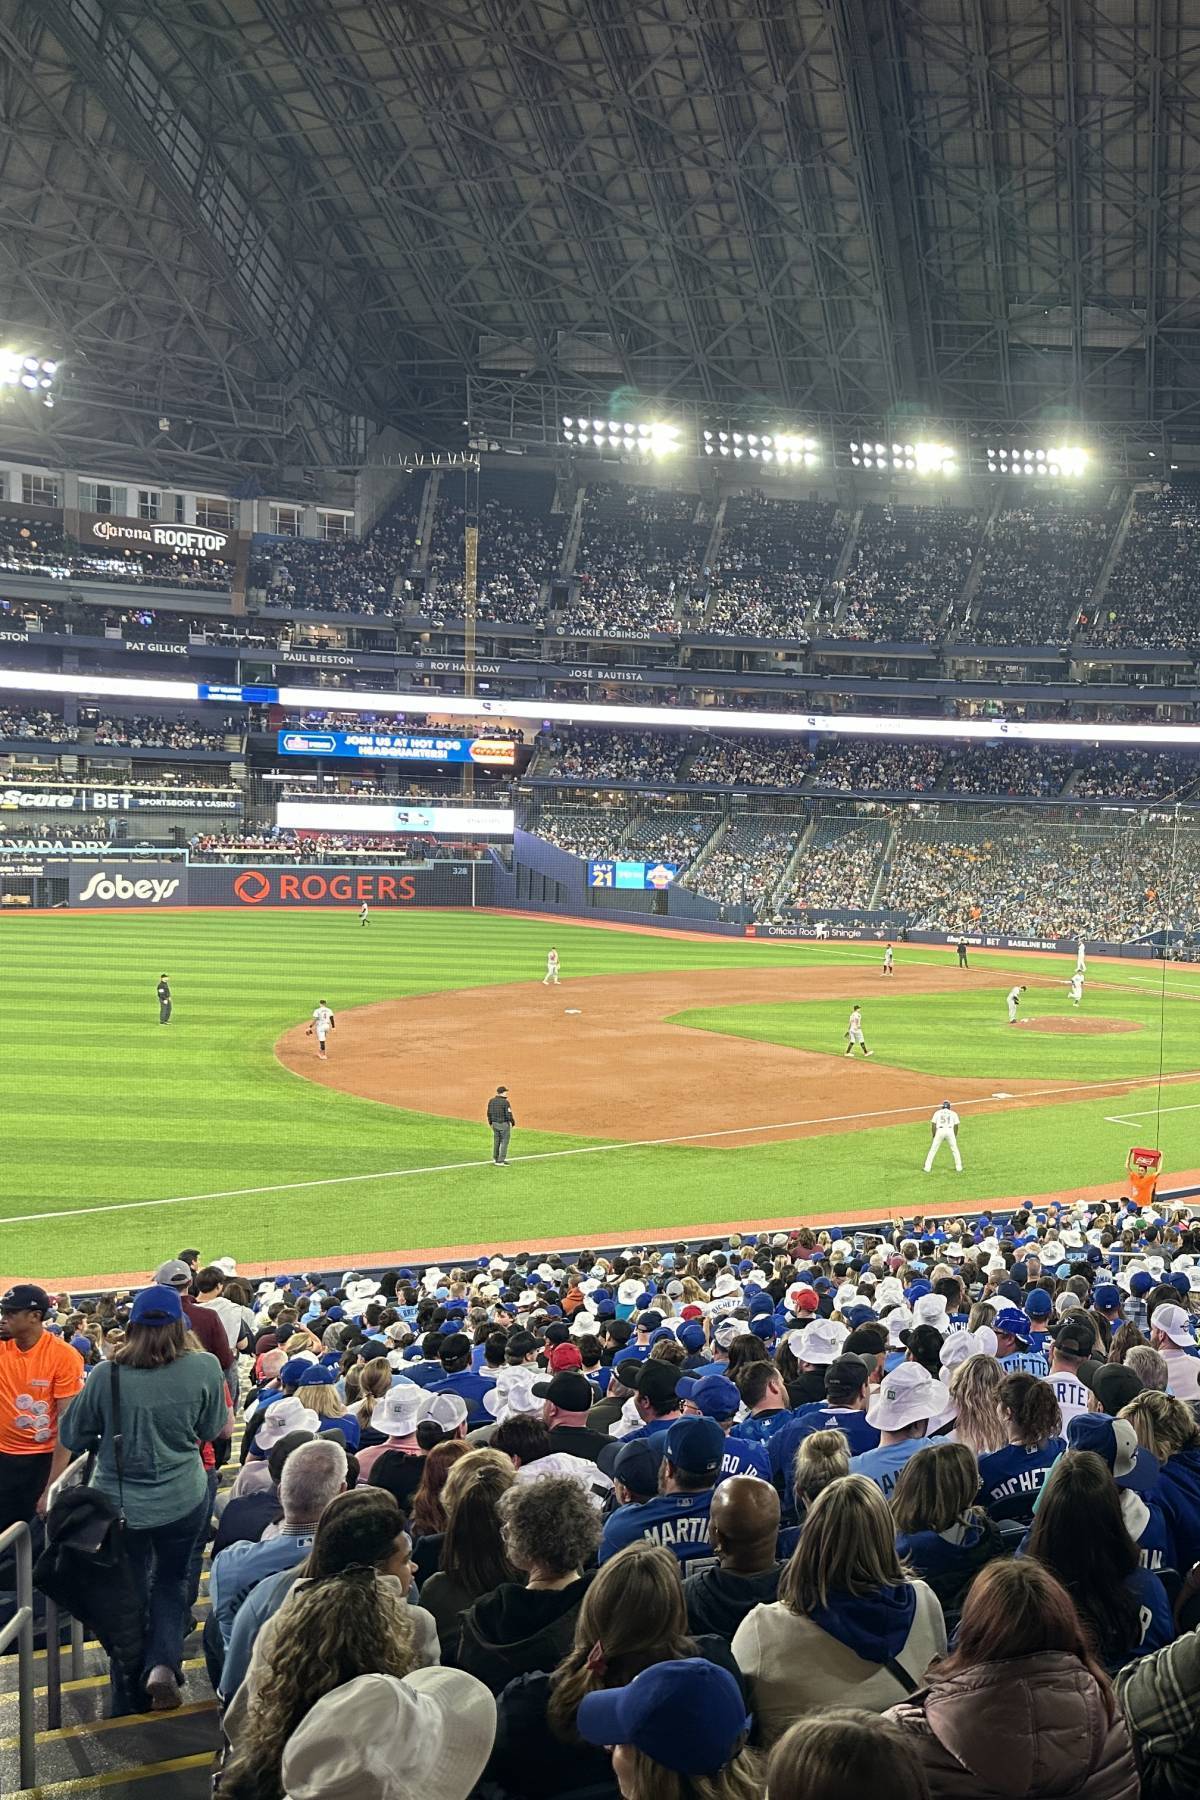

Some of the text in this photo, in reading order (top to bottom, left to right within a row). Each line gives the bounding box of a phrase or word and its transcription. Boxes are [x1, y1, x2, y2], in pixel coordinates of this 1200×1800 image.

[93, 521, 227, 550] Corona ROOFTOP
[175, 547, 206, 556] PATIO
[0, 632, 29, 642] STON
[569, 628, 601, 637] JACKIE
[603, 629, 650, 639] ROBINSON
[126, 641, 188, 654] PAT GILLICK
[283, 652, 354, 665] PAUL BEESTON
[430, 662, 450, 671] ROY
[452, 663, 500, 673] HALLADAY
[569, 669, 643, 681] JOSÉ BAUTISTA
[344, 736, 462, 751] JOIN US AT HOT DOG
[359, 746, 448, 759] HEADQUARTERS!
[93, 793, 134, 809] BET
[138, 798, 195, 807] SPORTSBOOK
[204, 800, 236, 809] CASINO
[452, 867, 468, 875] 328
[593, 864, 613, 872] MAY
[592, 871, 612, 886] 21
[79, 872, 180, 903] Sobeys
[280, 875, 416, 900] ROGERS
[768, 927, 797, 936] Official
[831, 928, 862, 939] Shingle
[987, 938, 1000, 946] BET
[1008, 940, 1040, 948] BASELINE
